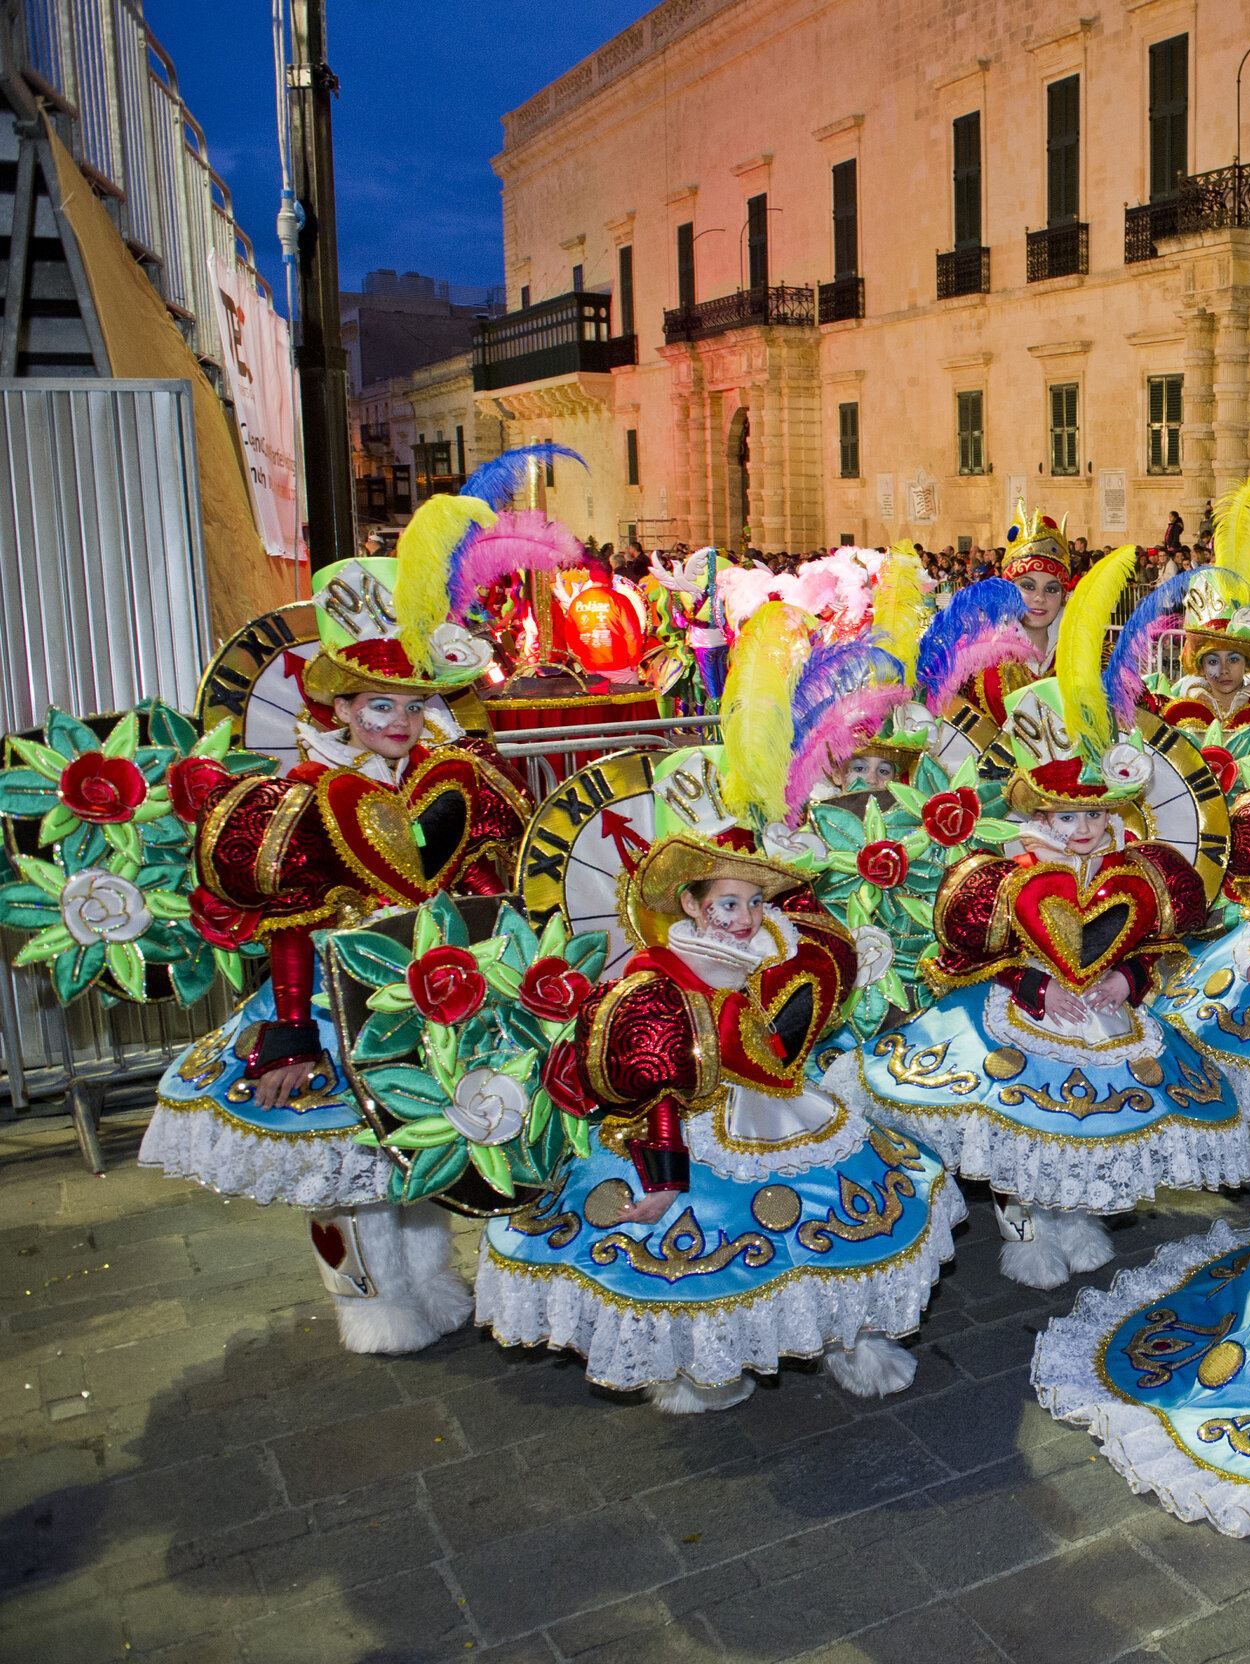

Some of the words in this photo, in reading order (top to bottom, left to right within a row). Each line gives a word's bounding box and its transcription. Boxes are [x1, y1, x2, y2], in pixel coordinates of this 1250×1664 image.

[236, 613, 296, 669] XII
[208, 664, 252, 717] XI
[552, 767, 615, 827] XII
[1184, 766, 1224, 802] III
[527, 826, 572, 884] XI
